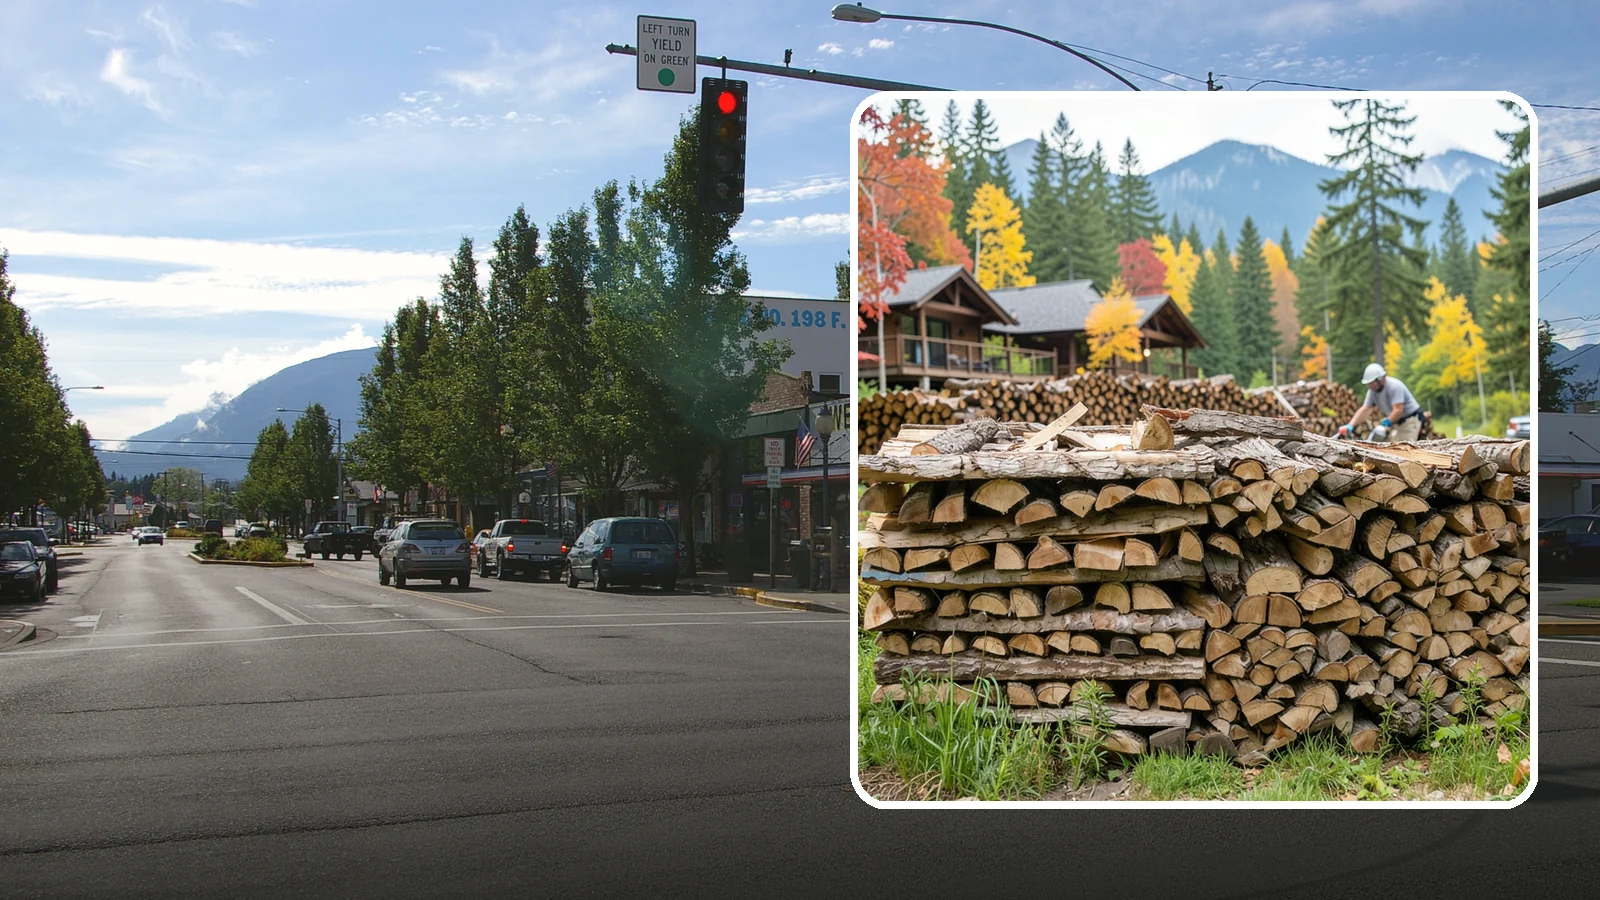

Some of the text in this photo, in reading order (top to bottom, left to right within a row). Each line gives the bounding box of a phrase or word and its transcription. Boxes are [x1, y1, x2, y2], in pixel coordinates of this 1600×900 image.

[643, 24, 690, 36] LEFT TURN
[652, 38, 682, 51] YIELD
[644, 53, 688, 66] ON GREEN
[791, 309, 826, 328] 198
[831, 311, 846, 329] F.
